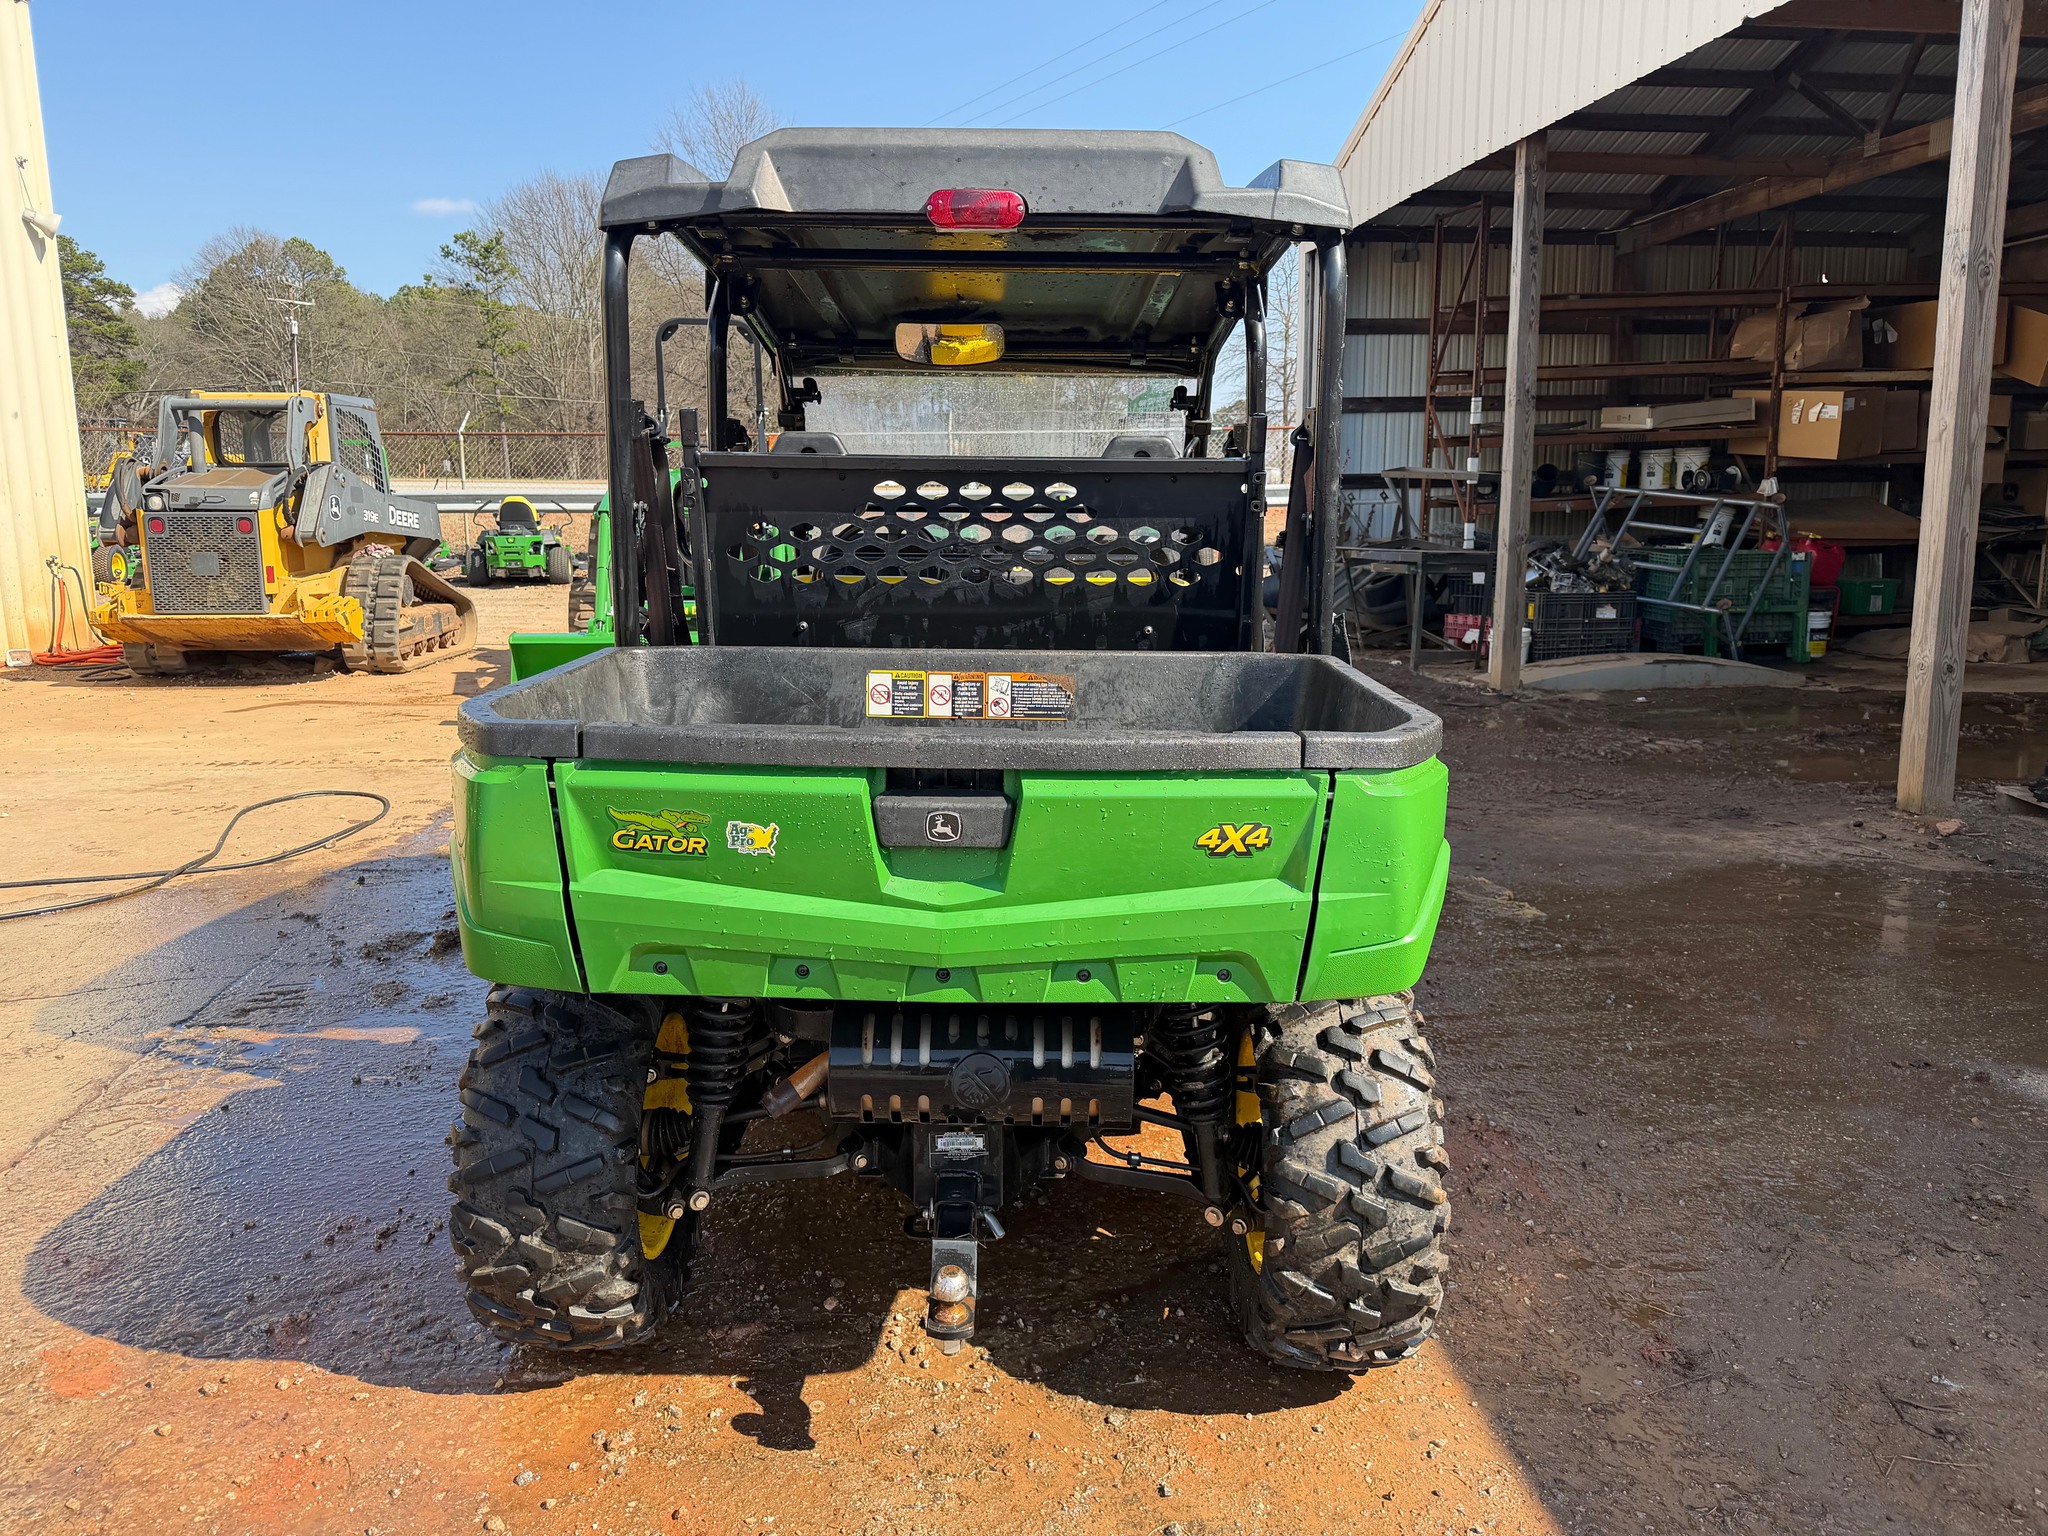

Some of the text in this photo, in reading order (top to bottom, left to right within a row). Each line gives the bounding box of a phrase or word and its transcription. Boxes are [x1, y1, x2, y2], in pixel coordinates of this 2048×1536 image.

[363, 509, 380, 524] 319E
[388, 504, 420, 530] DEERE
[730, 823, 754, 838] Ag-
[611, 829, 709, 855] GATOR
[730, 835, 755, 846] Pro
